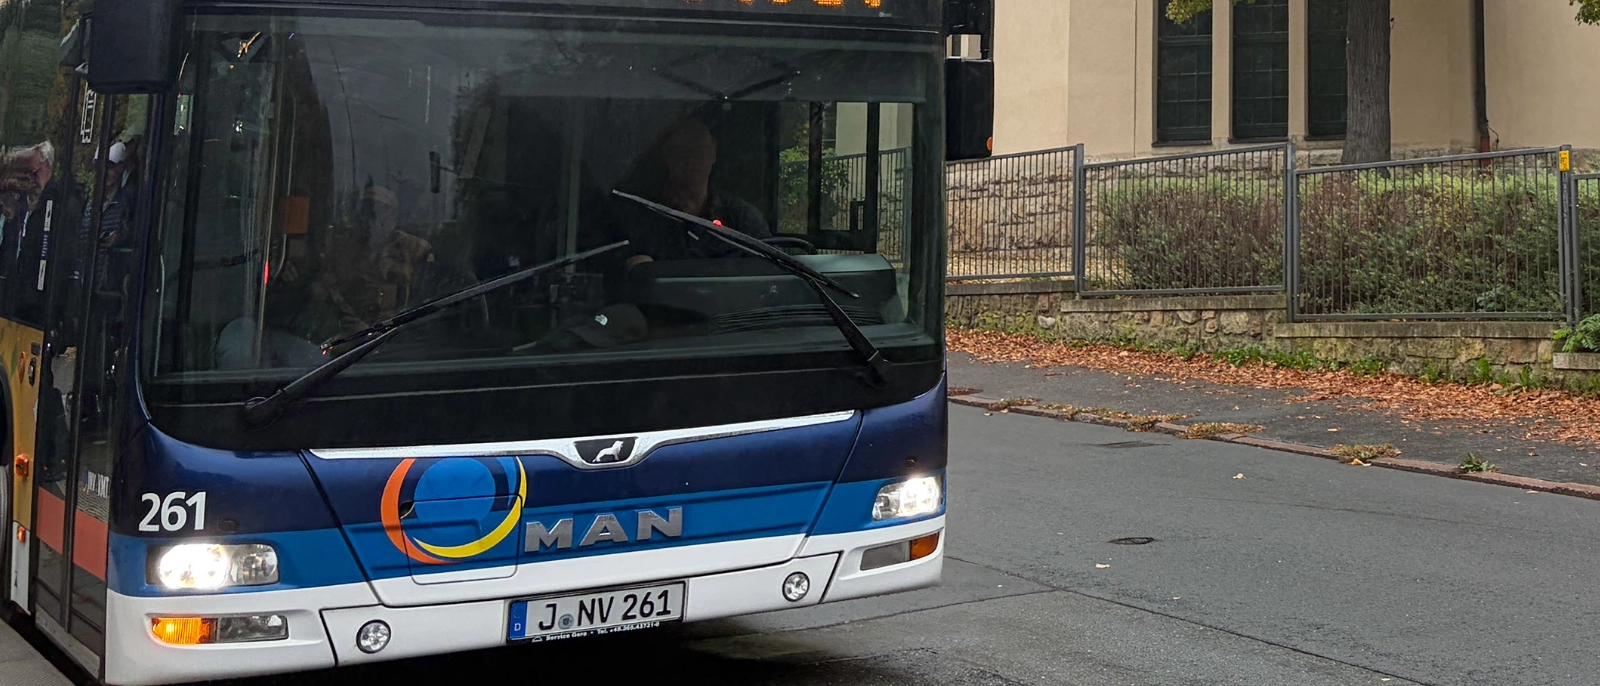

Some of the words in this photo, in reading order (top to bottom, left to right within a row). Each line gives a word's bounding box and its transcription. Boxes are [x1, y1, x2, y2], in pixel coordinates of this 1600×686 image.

[139, 491, 206, 532] 261
[524, 506, 683, 552] MAN
[514, 623, 521, 632] D
[538, 603, 557, 631] J
[577, 596, 614, 626] NV
[622, 589, 671, 621] 261
[546, 633, 570, 641] Service
